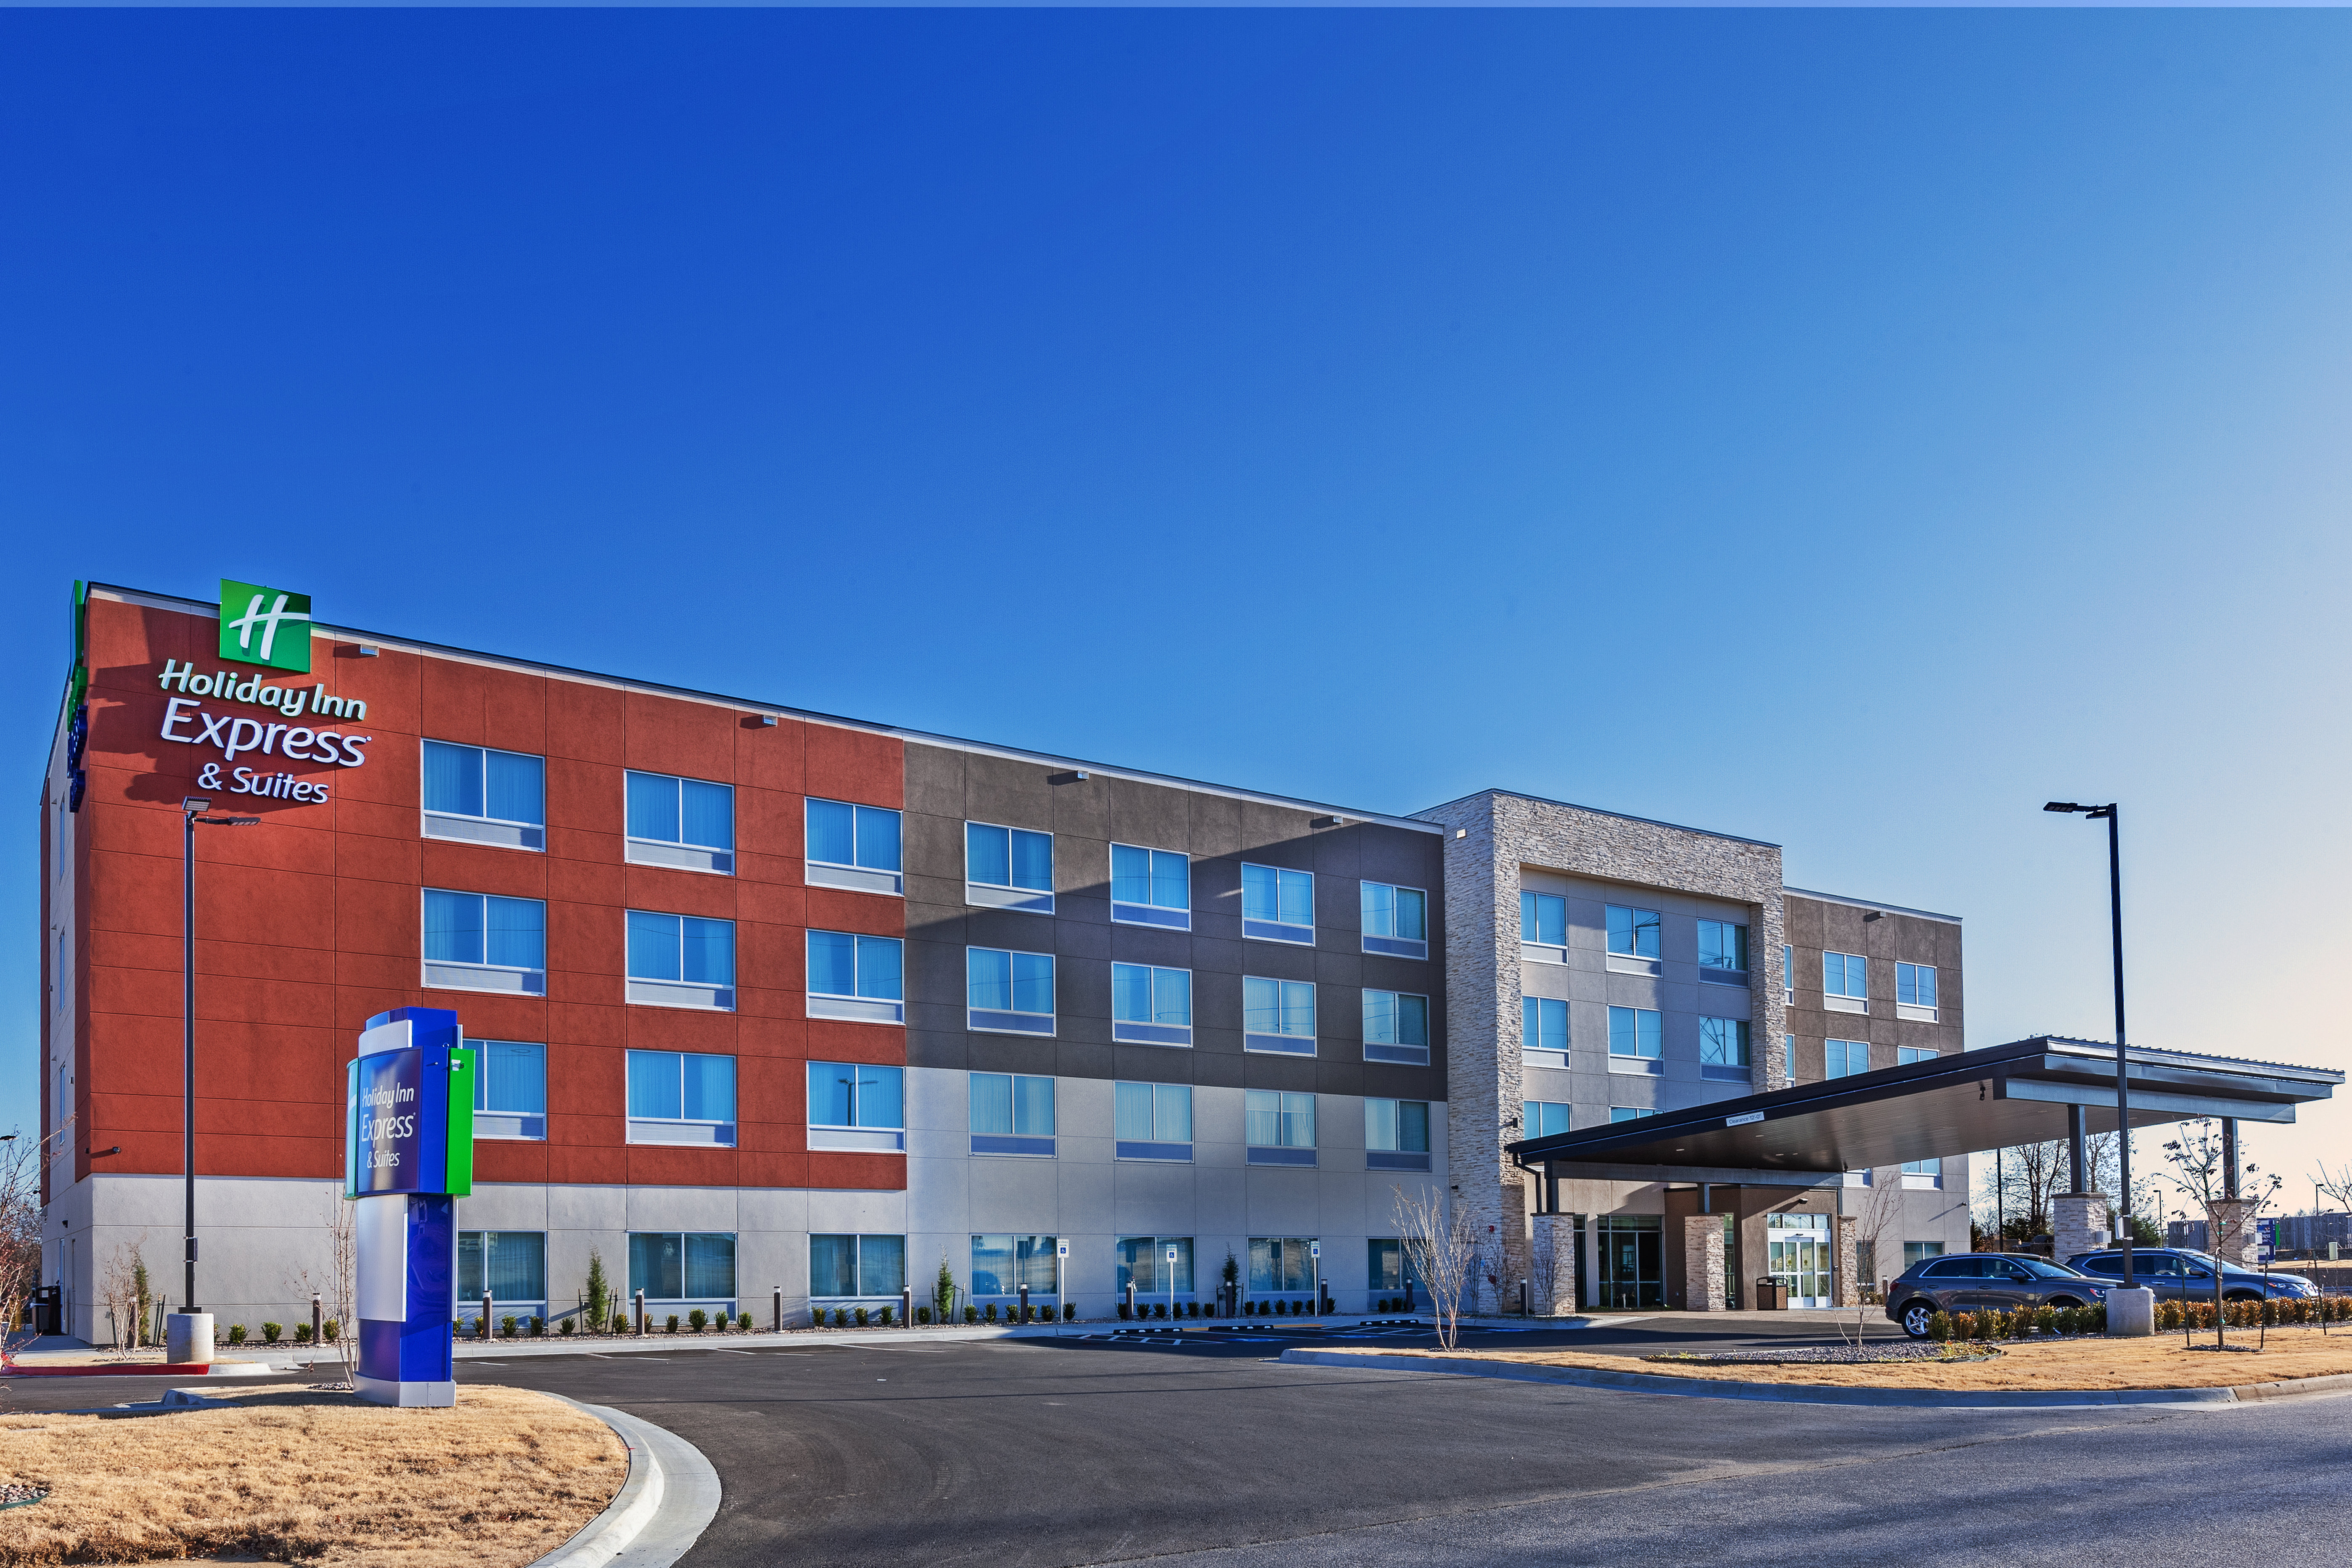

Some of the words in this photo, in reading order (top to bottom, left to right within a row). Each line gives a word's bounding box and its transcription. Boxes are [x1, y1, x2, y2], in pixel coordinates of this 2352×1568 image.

[159, 658, 307, 716] Holiday
[312, 683, 367, 721] Inn
[161, 697, 368, 767] Express
[198, 763, 222, 791] &
[230, 767, 329, 804] Suites
[362, 1085, 395, 1109] Holiday
[396, 1082, 414, 1103] Inn
[361, 1113, 414, 1148] Express
[367, 1151, 373, 1169] &
[373, 1149, 400, 1168] Suites
